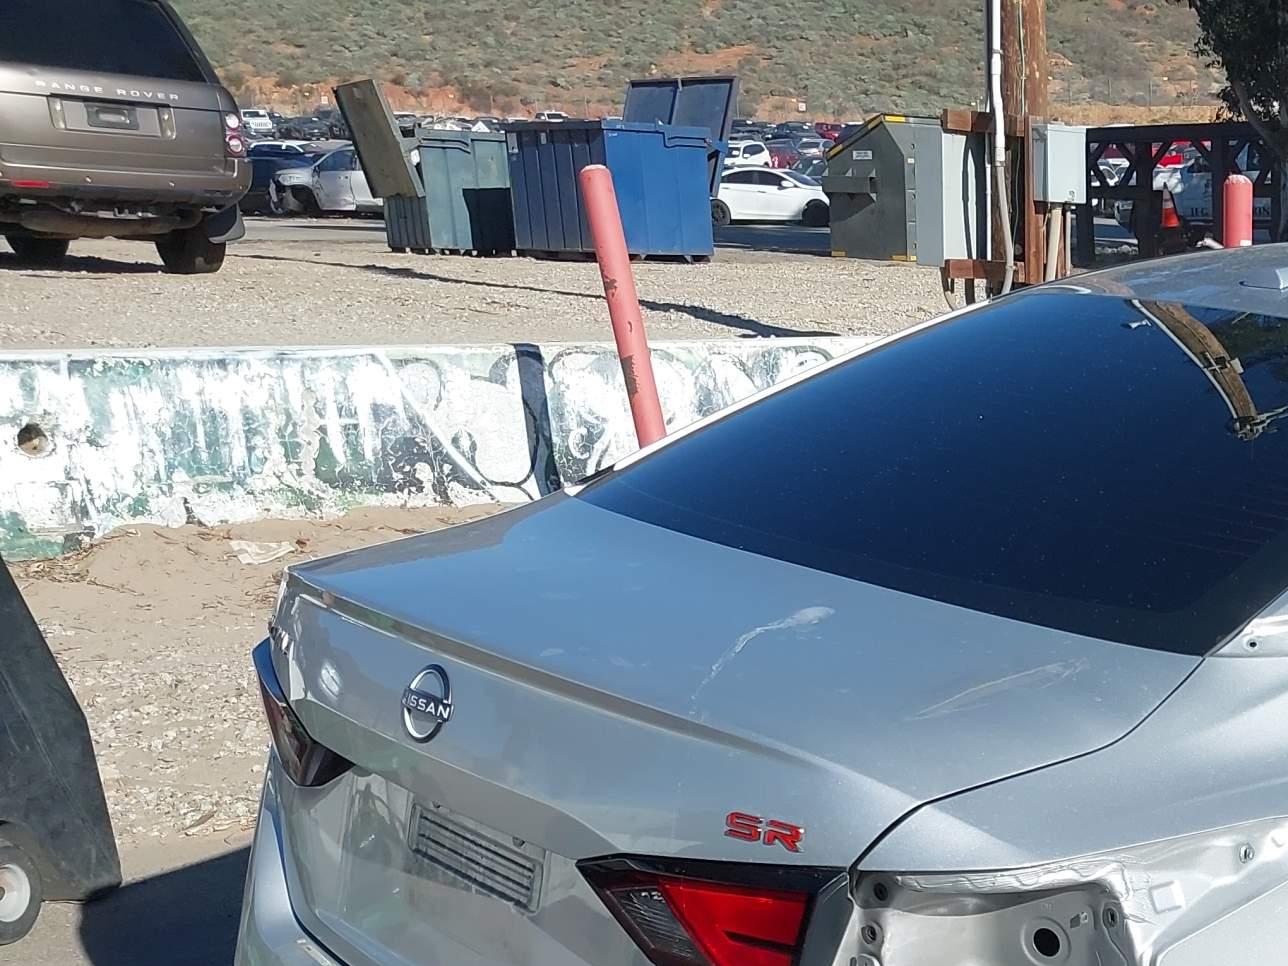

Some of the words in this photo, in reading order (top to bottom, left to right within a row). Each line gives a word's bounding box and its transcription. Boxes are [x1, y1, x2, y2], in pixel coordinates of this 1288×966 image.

[35, 80, 103, 93] RANGE
[116, 89, 179, 100] ROVER
[724, 812, 804, 853] SR
